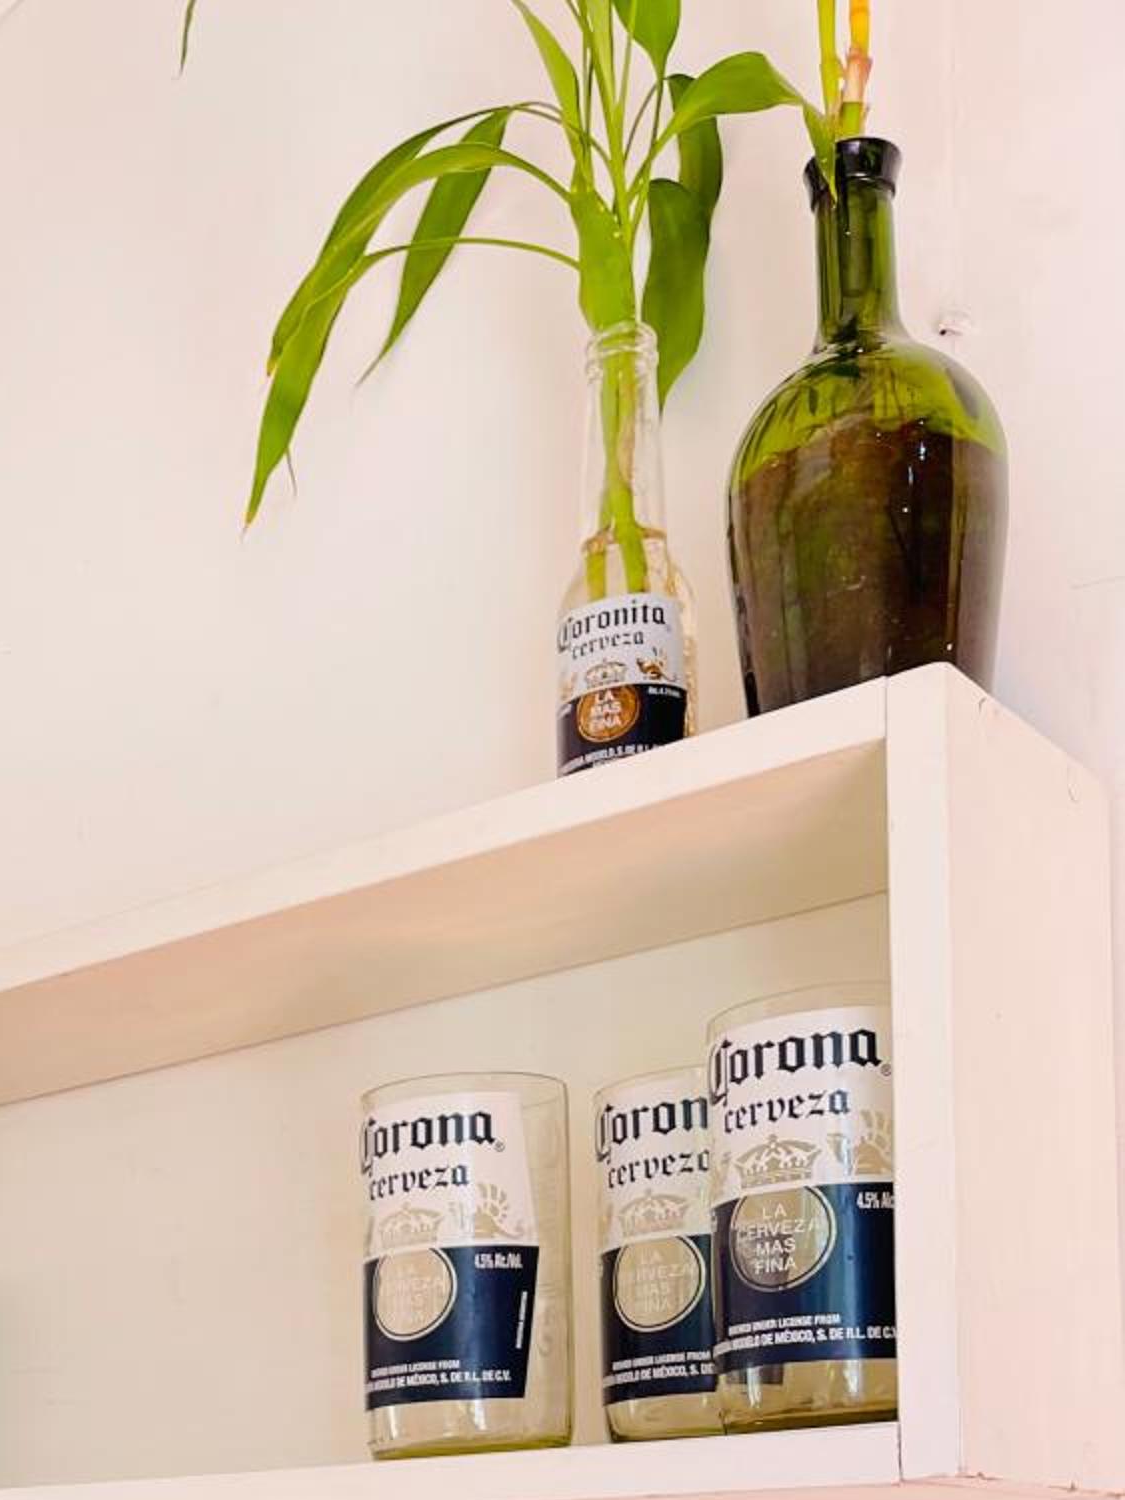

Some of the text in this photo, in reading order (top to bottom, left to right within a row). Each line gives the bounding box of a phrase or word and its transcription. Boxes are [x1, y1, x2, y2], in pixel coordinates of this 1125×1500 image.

[557, 599, 666, 653] Coronita
[572, 631, 644, 660] cerveza
[709, 1028, 882, 1107] Corona
[724, 1088, 849, 1134] cerveza
[361, 1111, 496, 1178] Corona
[595, 1096, 709, 1164] Coron
[369, 1165, 469, 1201] cerveza
[857, 1192, 880, 1209] 4.5%
[762, 1202, 788, 1220] LA
[756, 1238, 796, 1256] MAS
[754, 1257, 797, 1275] FINA
